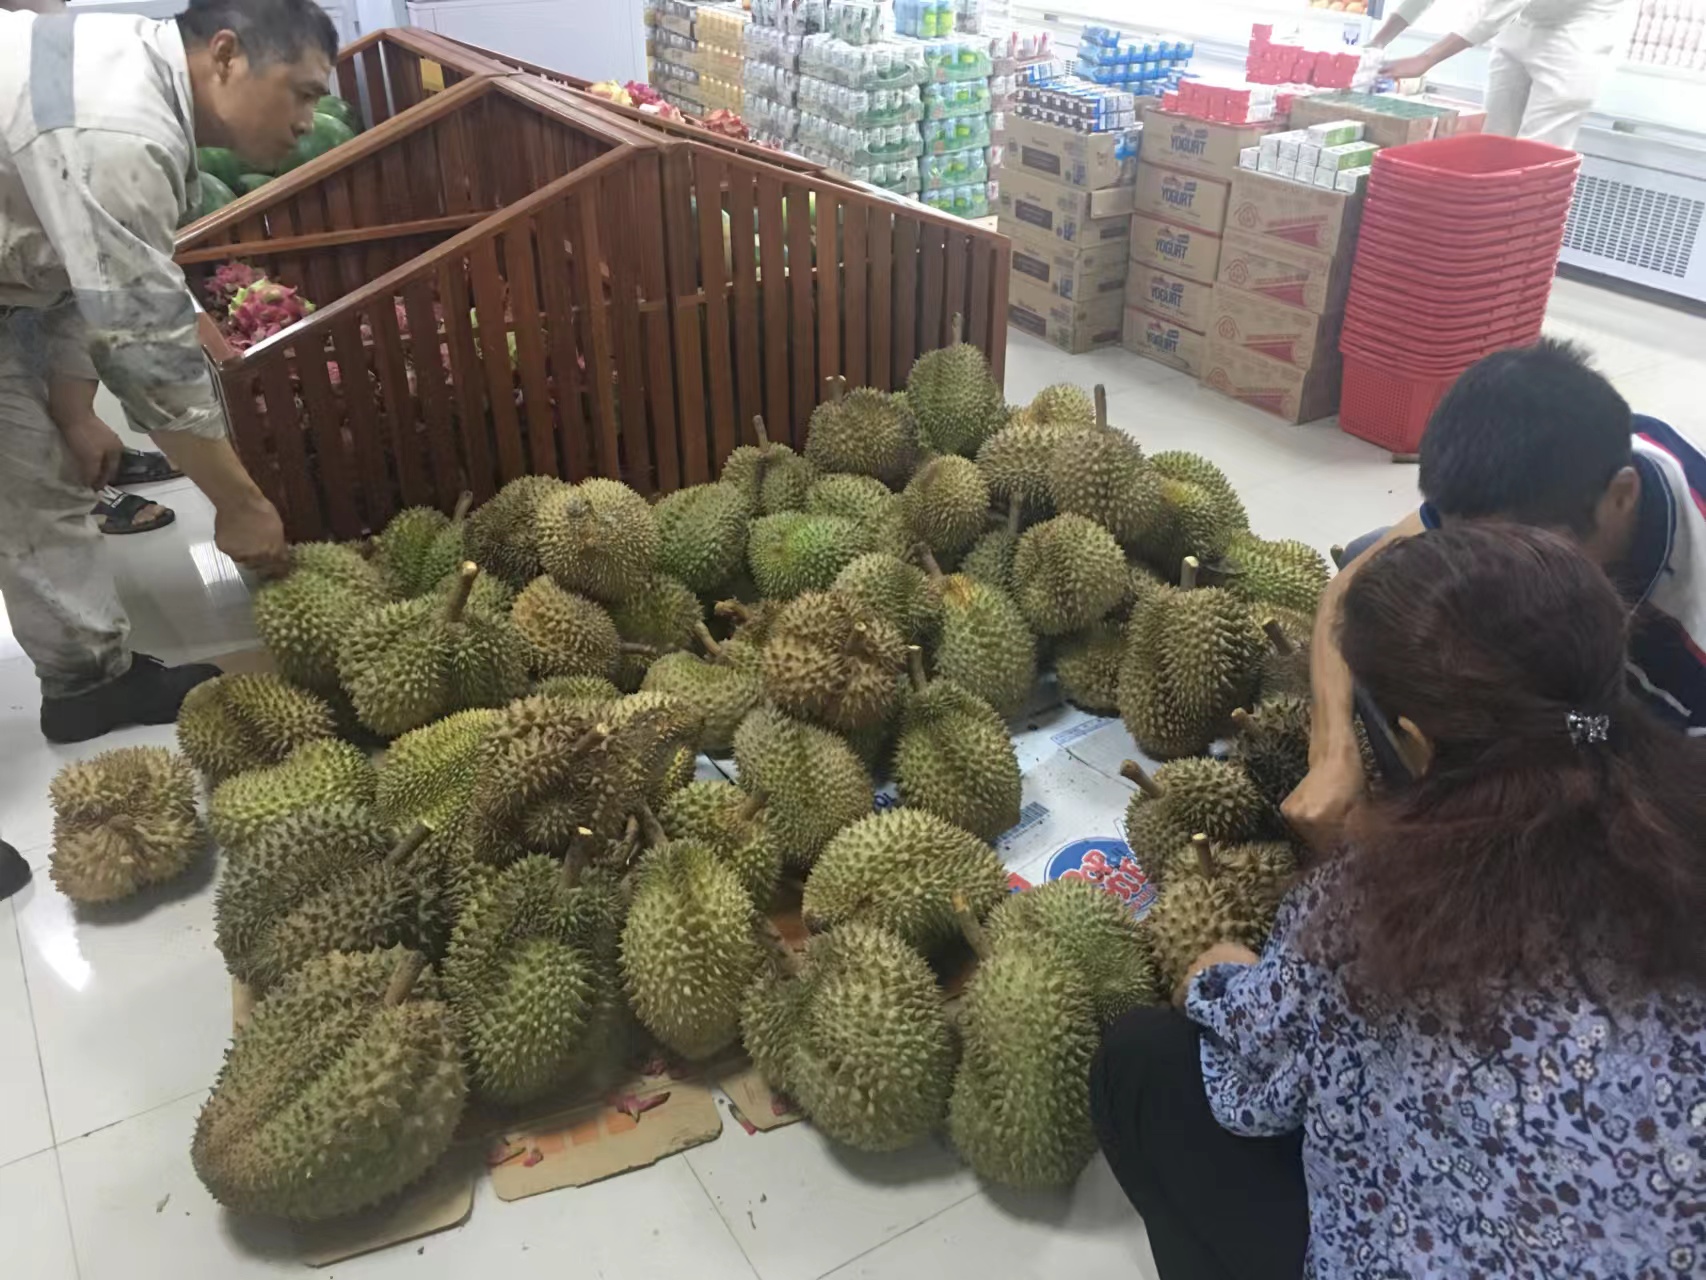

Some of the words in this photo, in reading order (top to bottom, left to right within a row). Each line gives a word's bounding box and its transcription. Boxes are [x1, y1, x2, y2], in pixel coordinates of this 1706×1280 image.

[1170, 134, 1207, 155] YOGURT
[1161, 185, 1195, 208] YOGURT
[1155, 238, 1188, 259] YOGURT
